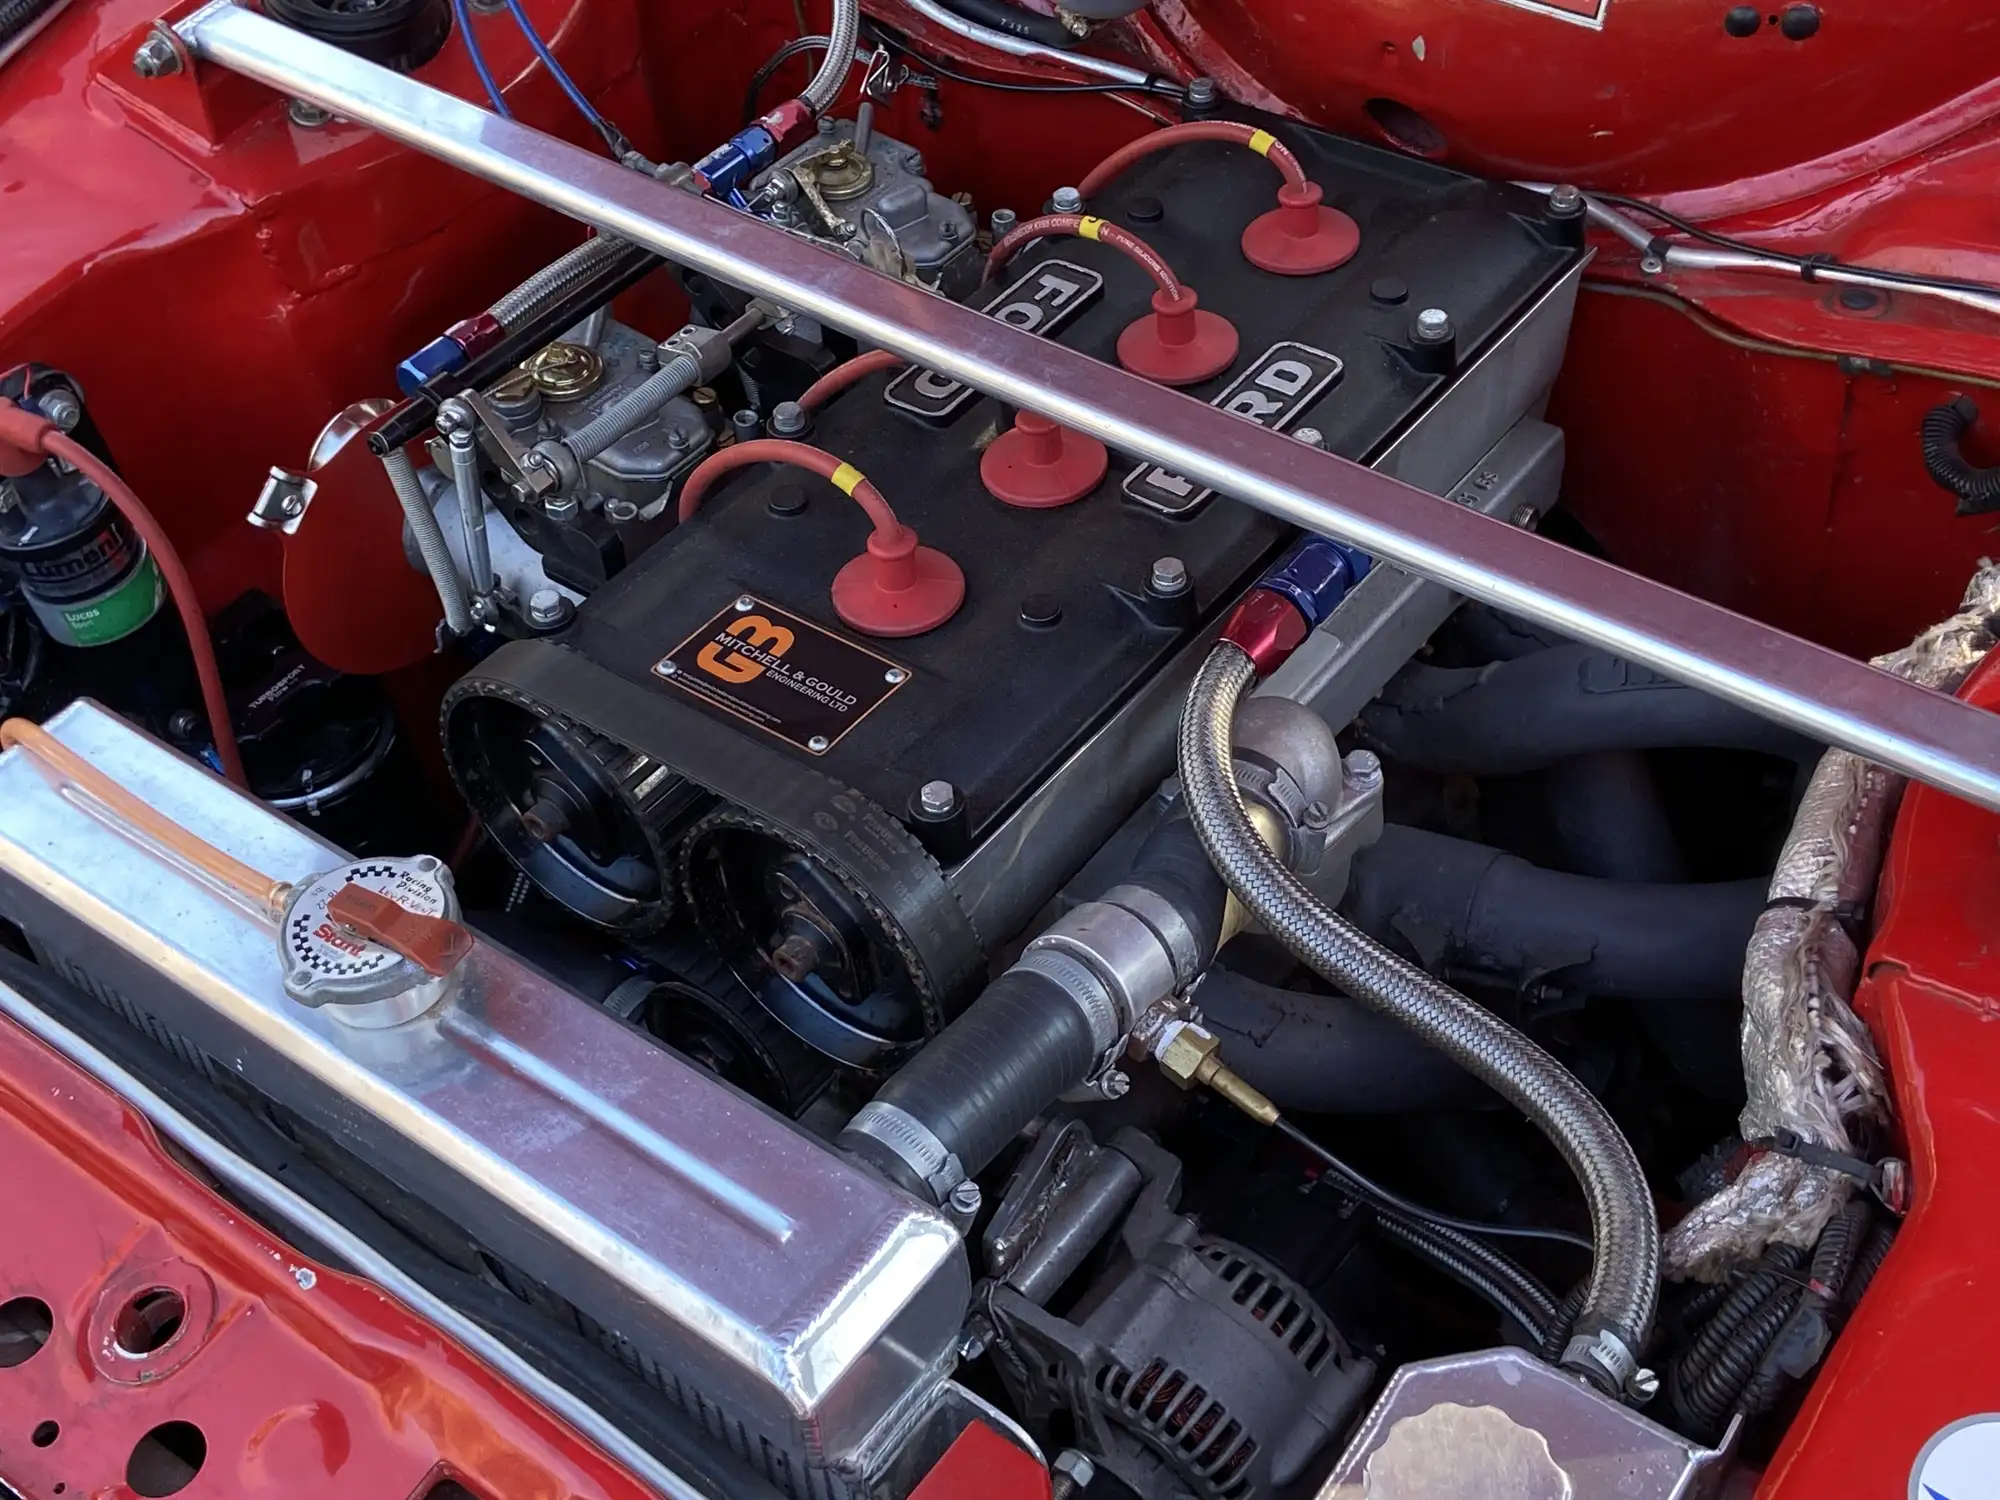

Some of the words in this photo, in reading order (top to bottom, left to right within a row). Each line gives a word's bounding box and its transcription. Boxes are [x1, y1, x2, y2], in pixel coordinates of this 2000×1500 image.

[1146, 360, 1312, 497] FRD
[65, 608, 101, 622] Lucas
[248, 664, 305, 708] TURBOSPORT
[715, 632, 792, 676] MITCHELL
[792, 670, 805, 682] &
[805, 676, 858, 706] GOULD
[766, 669, 829, 705] ENGINEERING
[828, 699, 848, 713] LTD
[396, 881, 438, 905] Division
[400, 870, 433, 892] Racing
